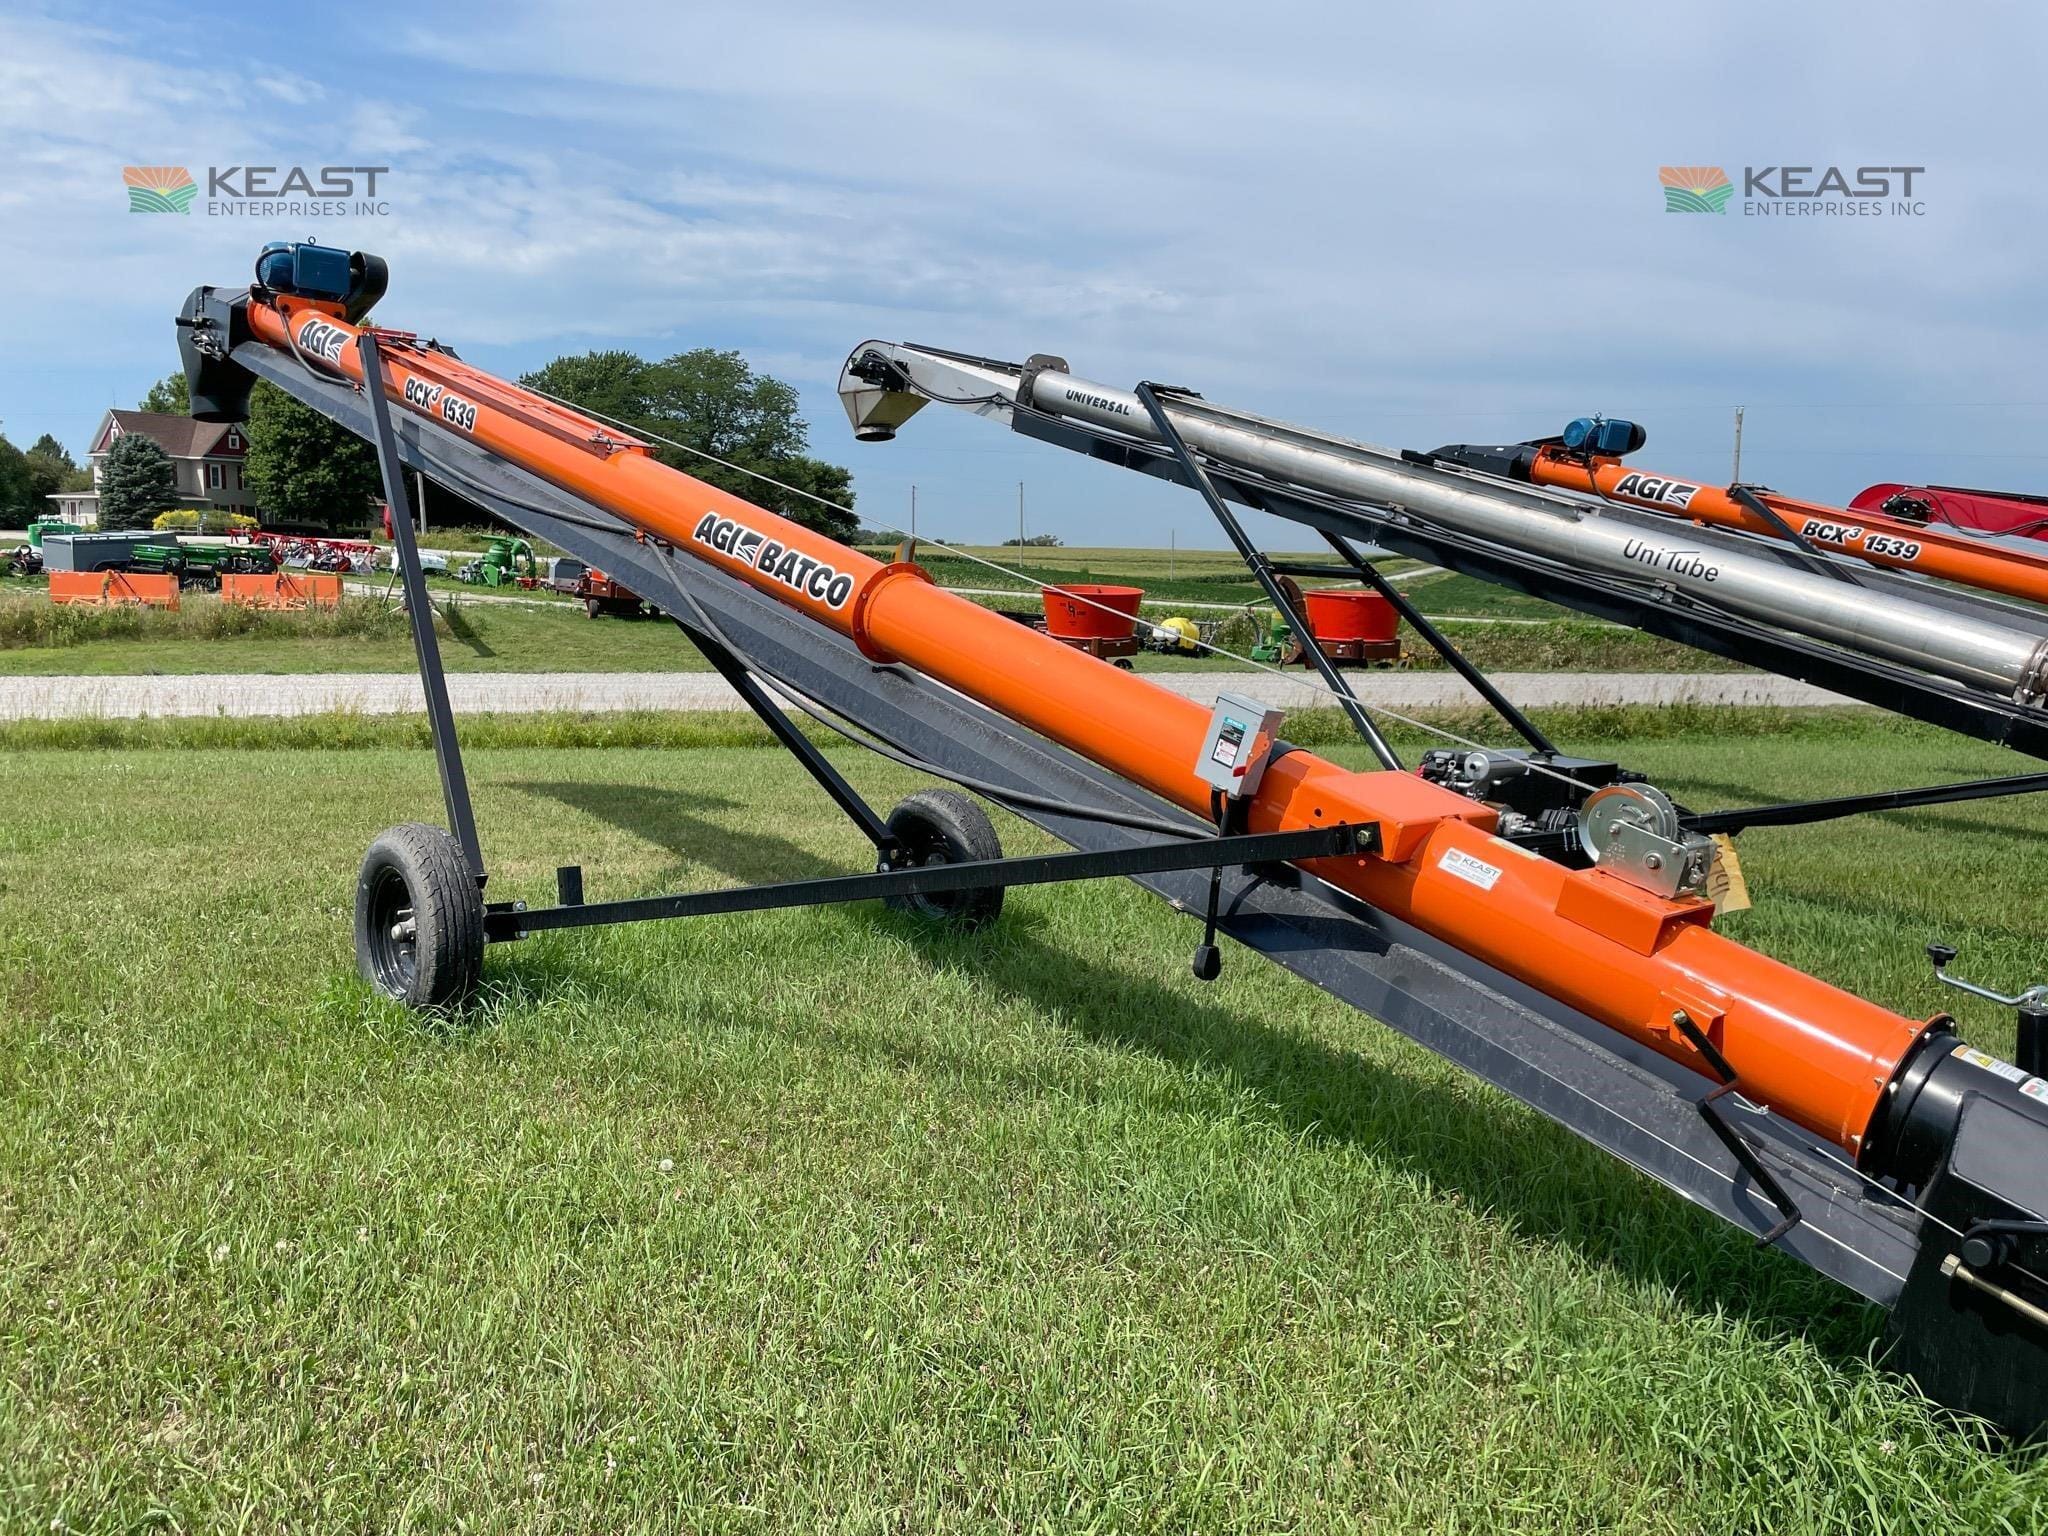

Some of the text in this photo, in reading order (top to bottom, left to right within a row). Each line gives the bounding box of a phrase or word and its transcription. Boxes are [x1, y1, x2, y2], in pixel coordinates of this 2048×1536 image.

[299, 319, 336, 357] AGI
[441, 396, 477, 432] 1539
[1066, 389, 1129, 416] UNIVERSAL
[1615, 473, 1673, 502] AGI
[694, 513, 854, 609] AGI BATCO
[1863, 533, 1920, 560] 1539
[1462, 857, 1499, 877] KEAST
